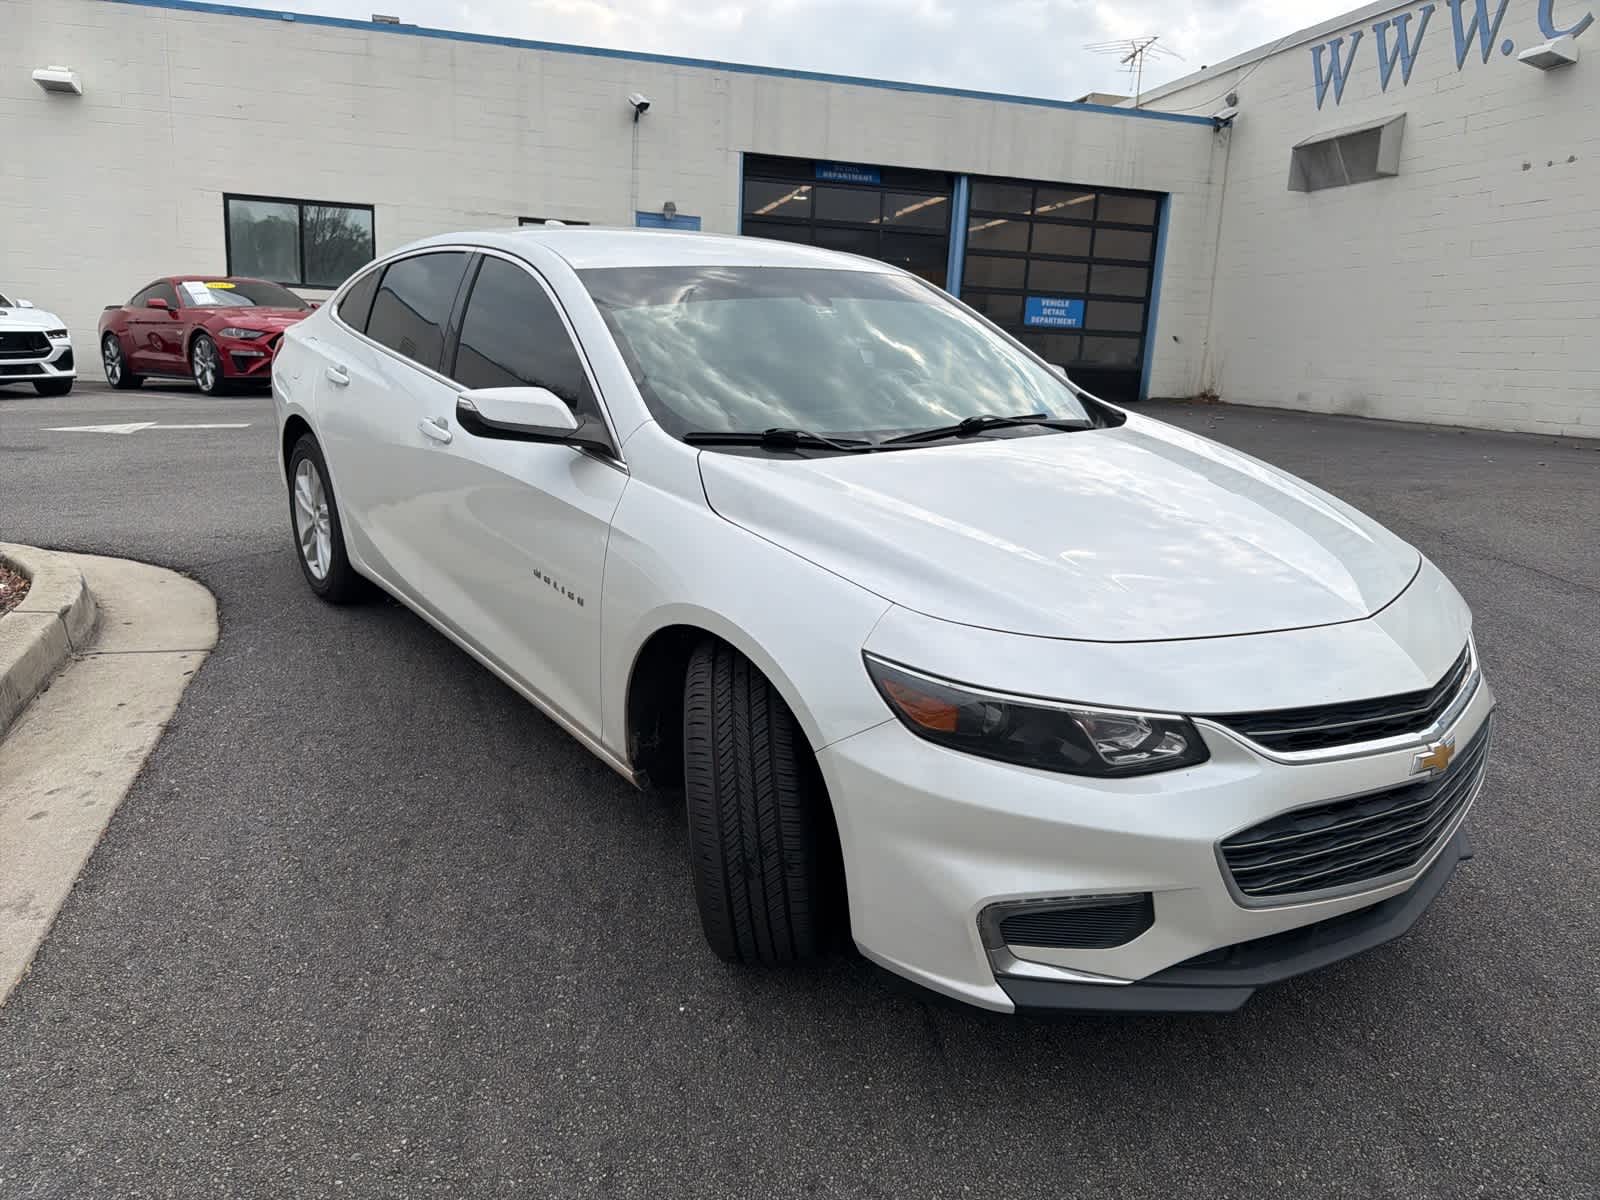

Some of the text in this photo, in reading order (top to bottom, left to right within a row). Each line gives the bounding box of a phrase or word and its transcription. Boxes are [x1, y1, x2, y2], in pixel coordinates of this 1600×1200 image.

[1041, 298, 1070, 307] VEHICLE
[1042, 307, 1067, 316] DETAIL
[1031, 316, 1077, 326] DEPARTMENT
